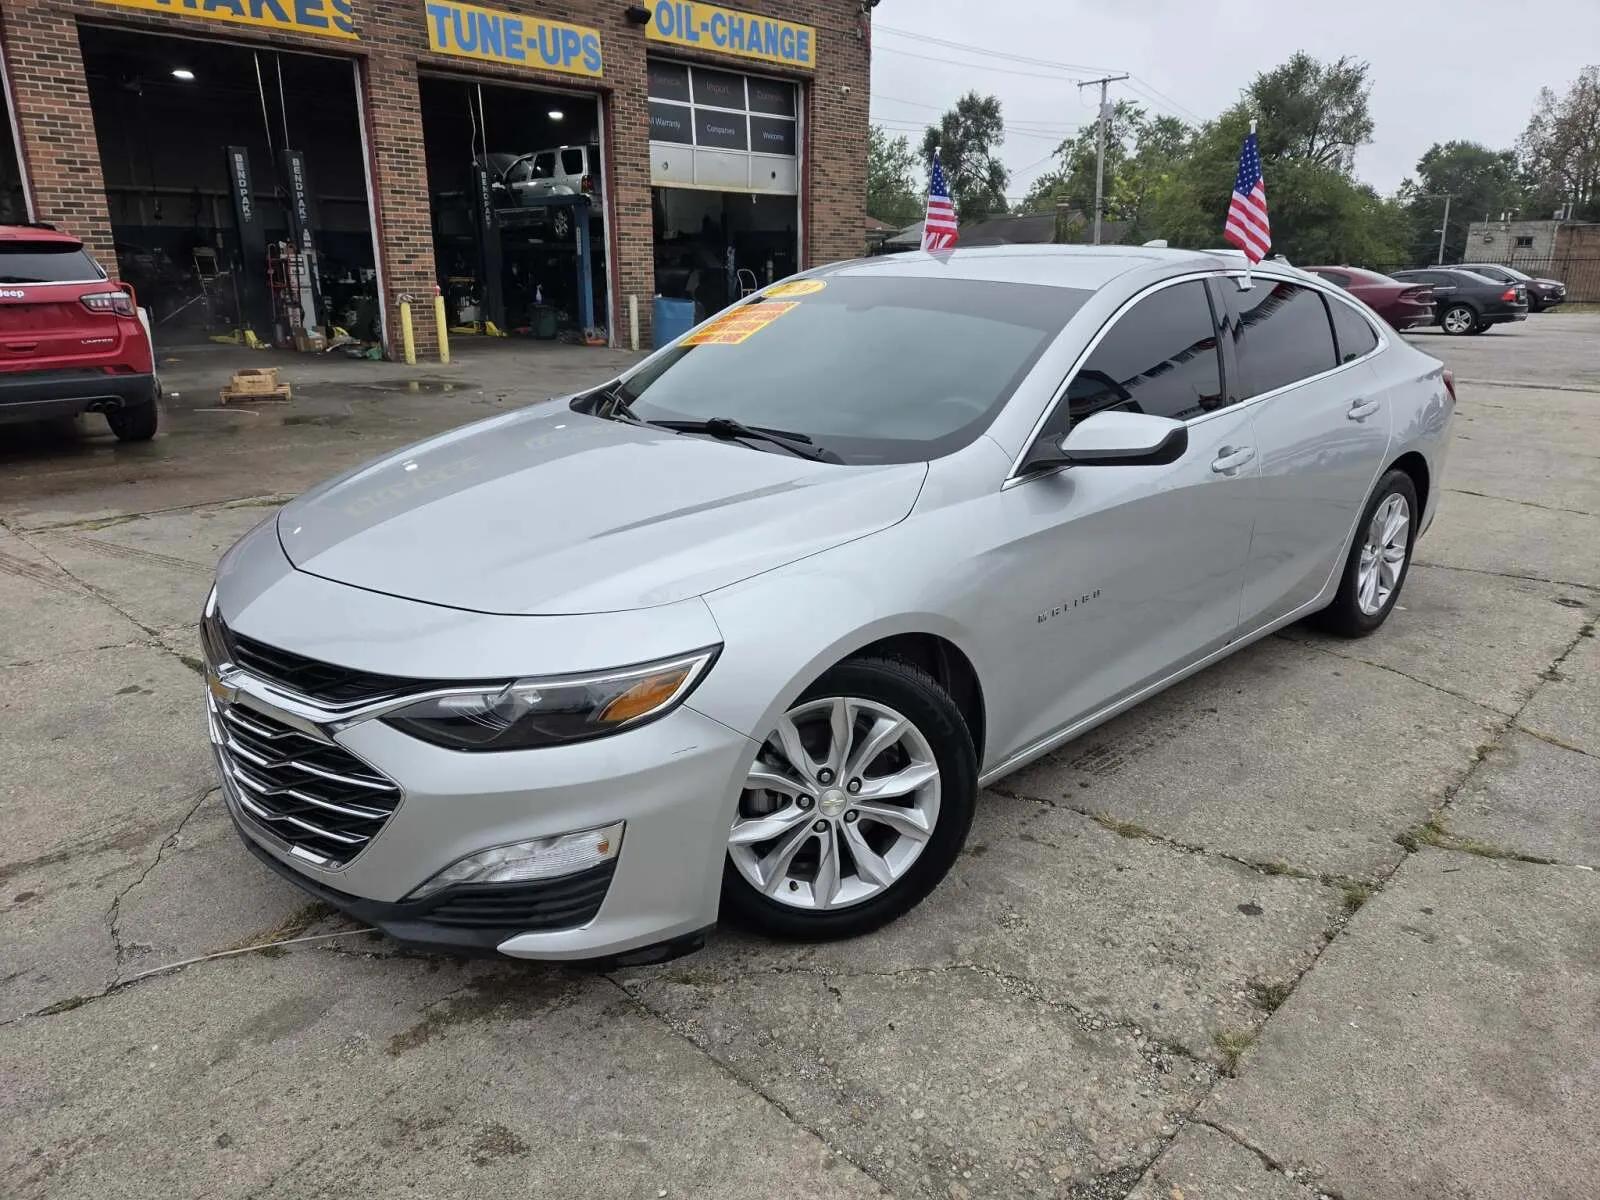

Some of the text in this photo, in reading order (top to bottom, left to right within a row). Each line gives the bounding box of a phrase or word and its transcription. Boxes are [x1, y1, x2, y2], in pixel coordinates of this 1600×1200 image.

[427, 3, 603, 71] TUNE-UPS
[655, 0, 809, 62] OIL-CHANGE
[234, 153, 251, 216] BENDPAK
[292, 158, 307, 217] BENDPAK
